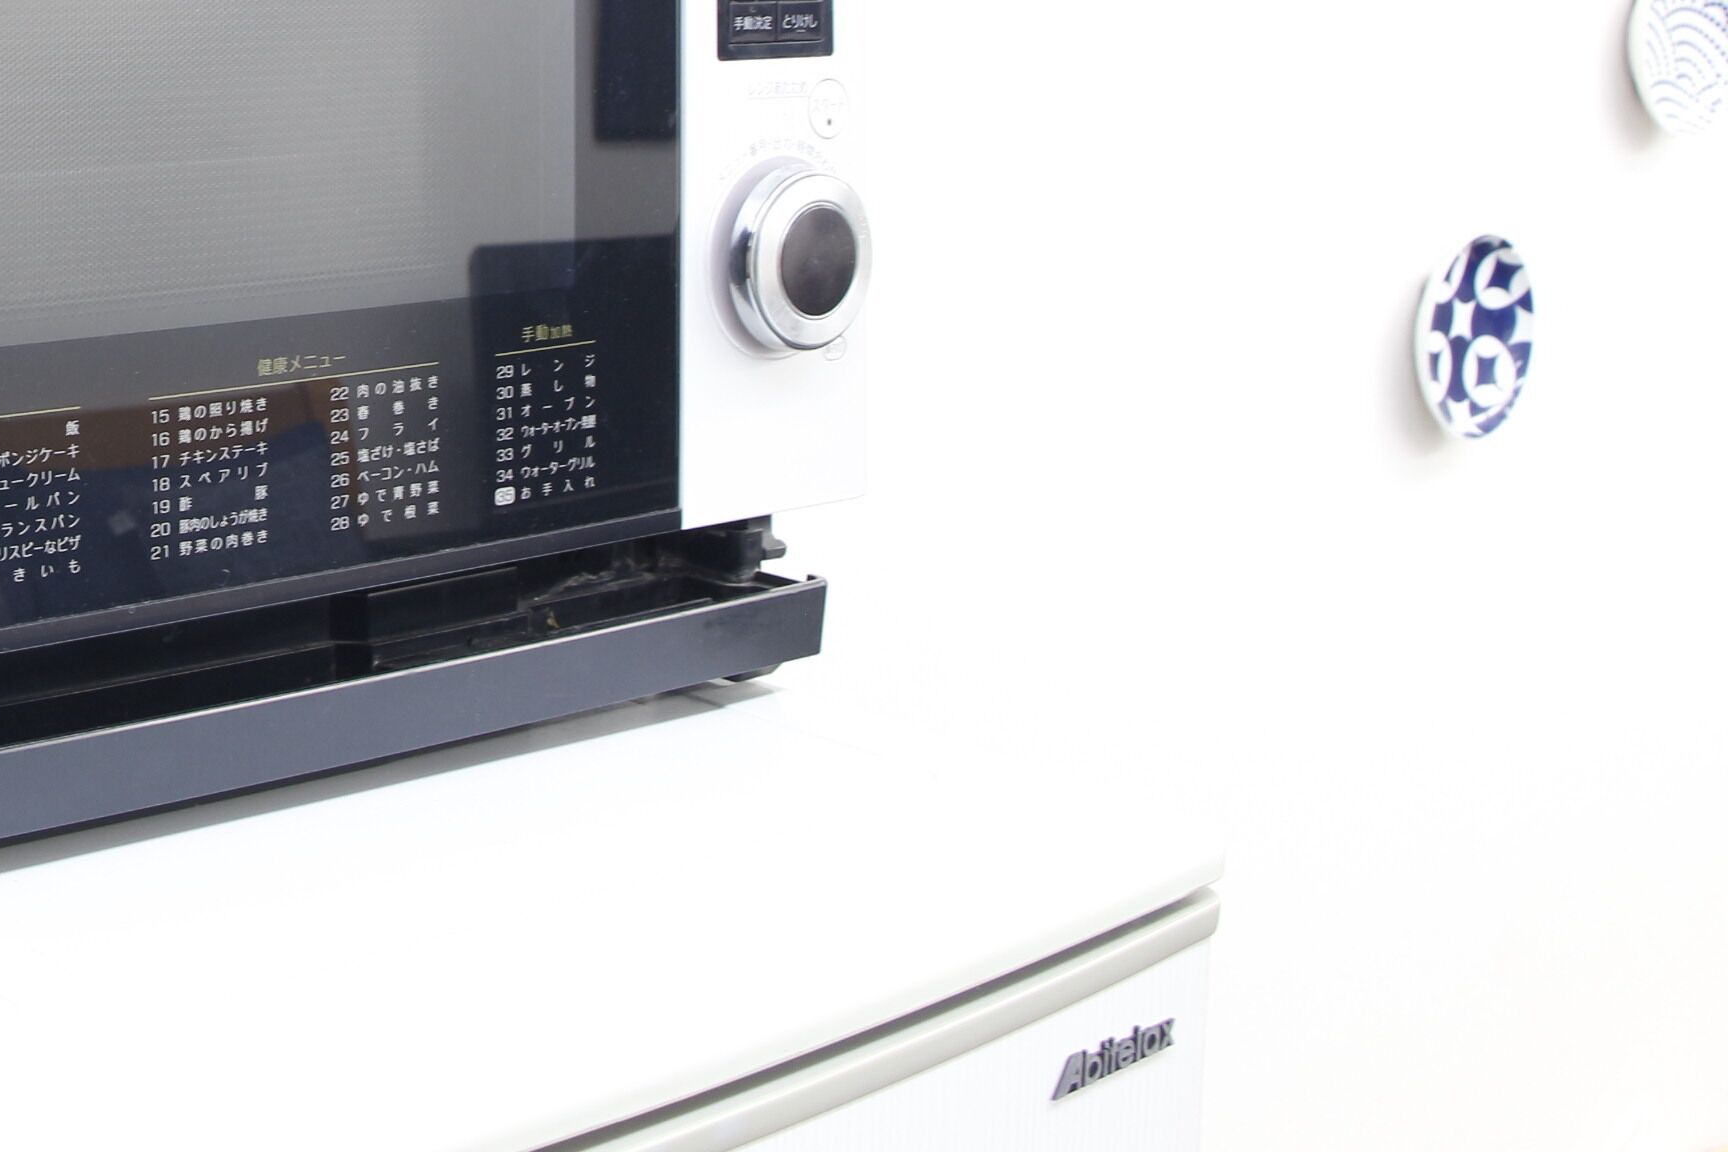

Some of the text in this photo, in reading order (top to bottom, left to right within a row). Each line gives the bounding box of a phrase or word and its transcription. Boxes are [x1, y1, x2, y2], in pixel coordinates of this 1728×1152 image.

[733, 15, 773, 31] 手動決定
[782, 13, 819, 30] とりけし
[257, 354, 346, 377] 健康メニュー
[496, 354, 595, 379] 29 レンジ
[330, 375, 439, 401] 22 肉の油抜き
[496, 385, 514, 399] 30
[151, 398, 268, 424] 15 鶏の照り焼き
[330, 397, 439, 422] 23 春巻き
[496, 396, 595, 421] 31 オーブン
[151, 418, 268, 447] 16 鶏のから揚げ
[331, 418, 439, 444] 24 フライ
[496, 427, 514, 441] 32
[151, 442, 269, 469] 17 チキンステーキ
[331, 438, 440, 466] 25 塩ざけ・塩さば
[496, 435, 595, 462] 33 グリル
[152, 463, 269, 492] 18 スペアリブ
[331, 460, 440, 488] 26 ベーコン・ハム
[496, 456, 596, 482] 34 ウォーターグリル
[331, 480, 439, 509] 27 ゆで青野菜
[521, 476, 595, 500] お手入れ
[152, 500, 171, 514] 19
[331, 502, 439, 531] 28 ゆで根菜
[150, 508, 268, 537] 20 豚肉のしょうが焼き
[150, 530, 268, 560] 21 野菜の肉巻き
[1051, 1017, 1176, 1101] Abitelax
